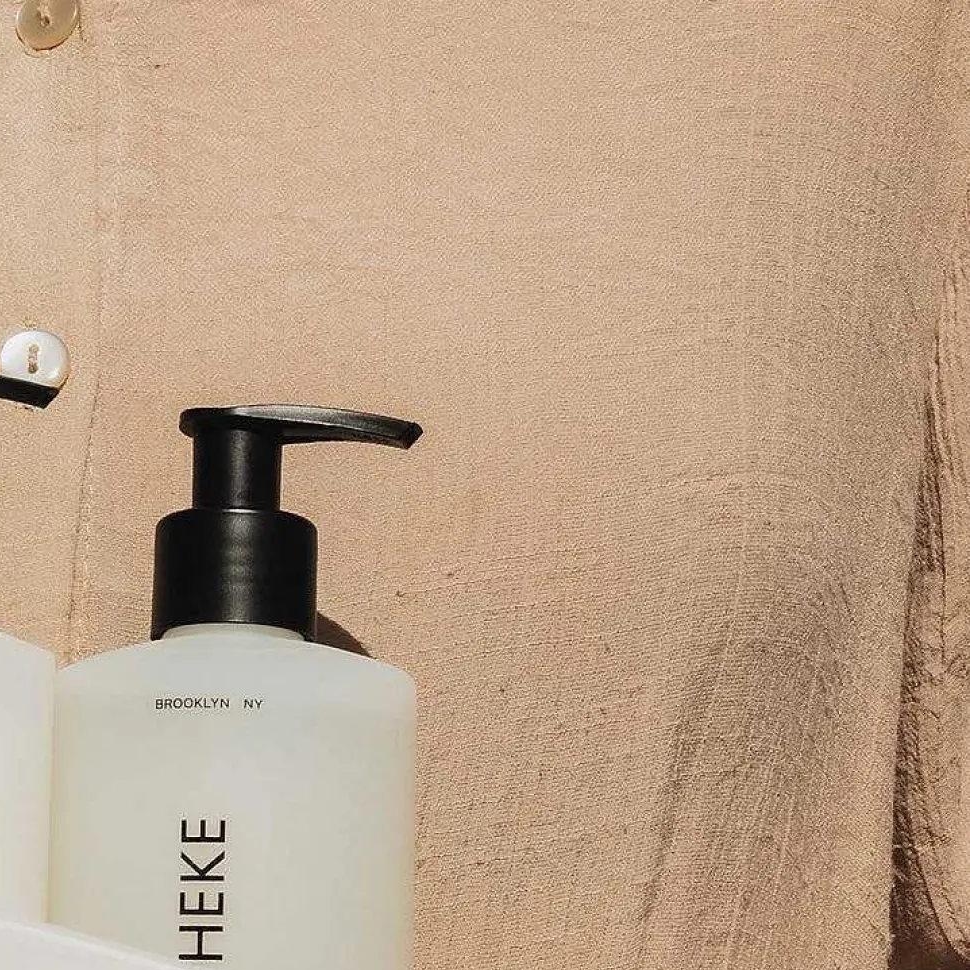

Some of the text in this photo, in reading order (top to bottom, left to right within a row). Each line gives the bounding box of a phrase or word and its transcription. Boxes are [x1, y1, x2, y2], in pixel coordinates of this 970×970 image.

[156, 698, 263, 710] BROOKLYN NY
[179, 819, 225, 960] HEKE
